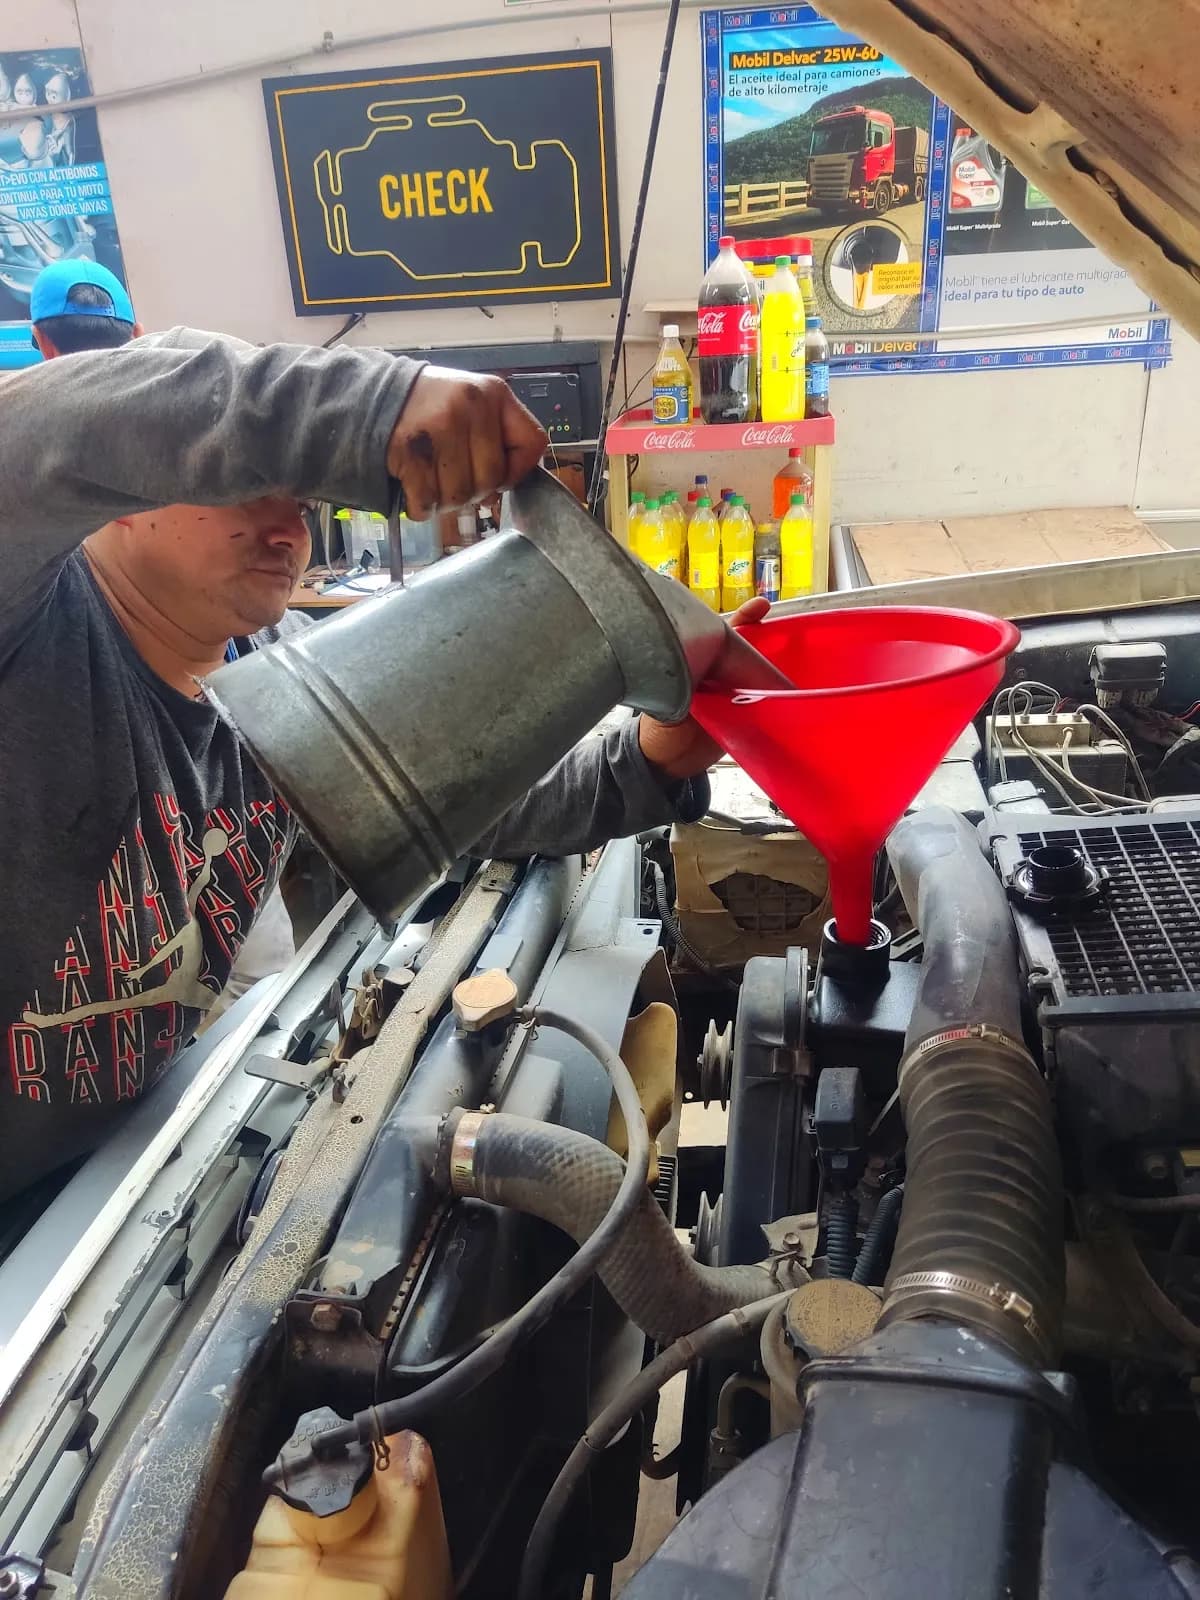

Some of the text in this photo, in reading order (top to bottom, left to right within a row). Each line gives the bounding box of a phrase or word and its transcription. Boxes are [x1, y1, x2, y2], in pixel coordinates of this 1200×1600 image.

[725, 10, 798, 26] Mobil Mobil
[732, 52, 770, 68] Mobil
[823, 46, 879, 63] 25W-60
[729, 67, 881, 85] El aceite ideal para camiones
[729, 83, 829, 98] de alto kilometraje
[709, 114, 719, 144] Mobil
[28, 170, 47, 184] CON
[709, 162, 719, 193] Mobil
[40, 187, 64, 200] PARA
[64, 186, 77, 198] TU
[78, 183, 104, 197] MOTO
[379, 167, 494, 219] CHECK
[19, 200, 108, 219] VAYAS DONDE VAYAS
[709, 212, 719, 242] Mobil
[981, 275, 1007, 287] tiene
[1010, 272, 1020, 284] el
[1021, 270, 1074, 283] lubricante
[1076, 267, 1128, 282] multigrad
[944, 284, 1085, 303] ideal para tu tipo de auto
[1108, 327, 1142, 339] Mobil
[832, 341, 871, 355] Mobil
[975, 354, 999, 365] Mobil
[1017, 352, 1044, 363] Mobil
[1062, 349, 1088, 360] Mobil
[1105, 347, 1132, 358] Mobil
[643, 424, 797, 450] Coca-Cola Coca-Cola
